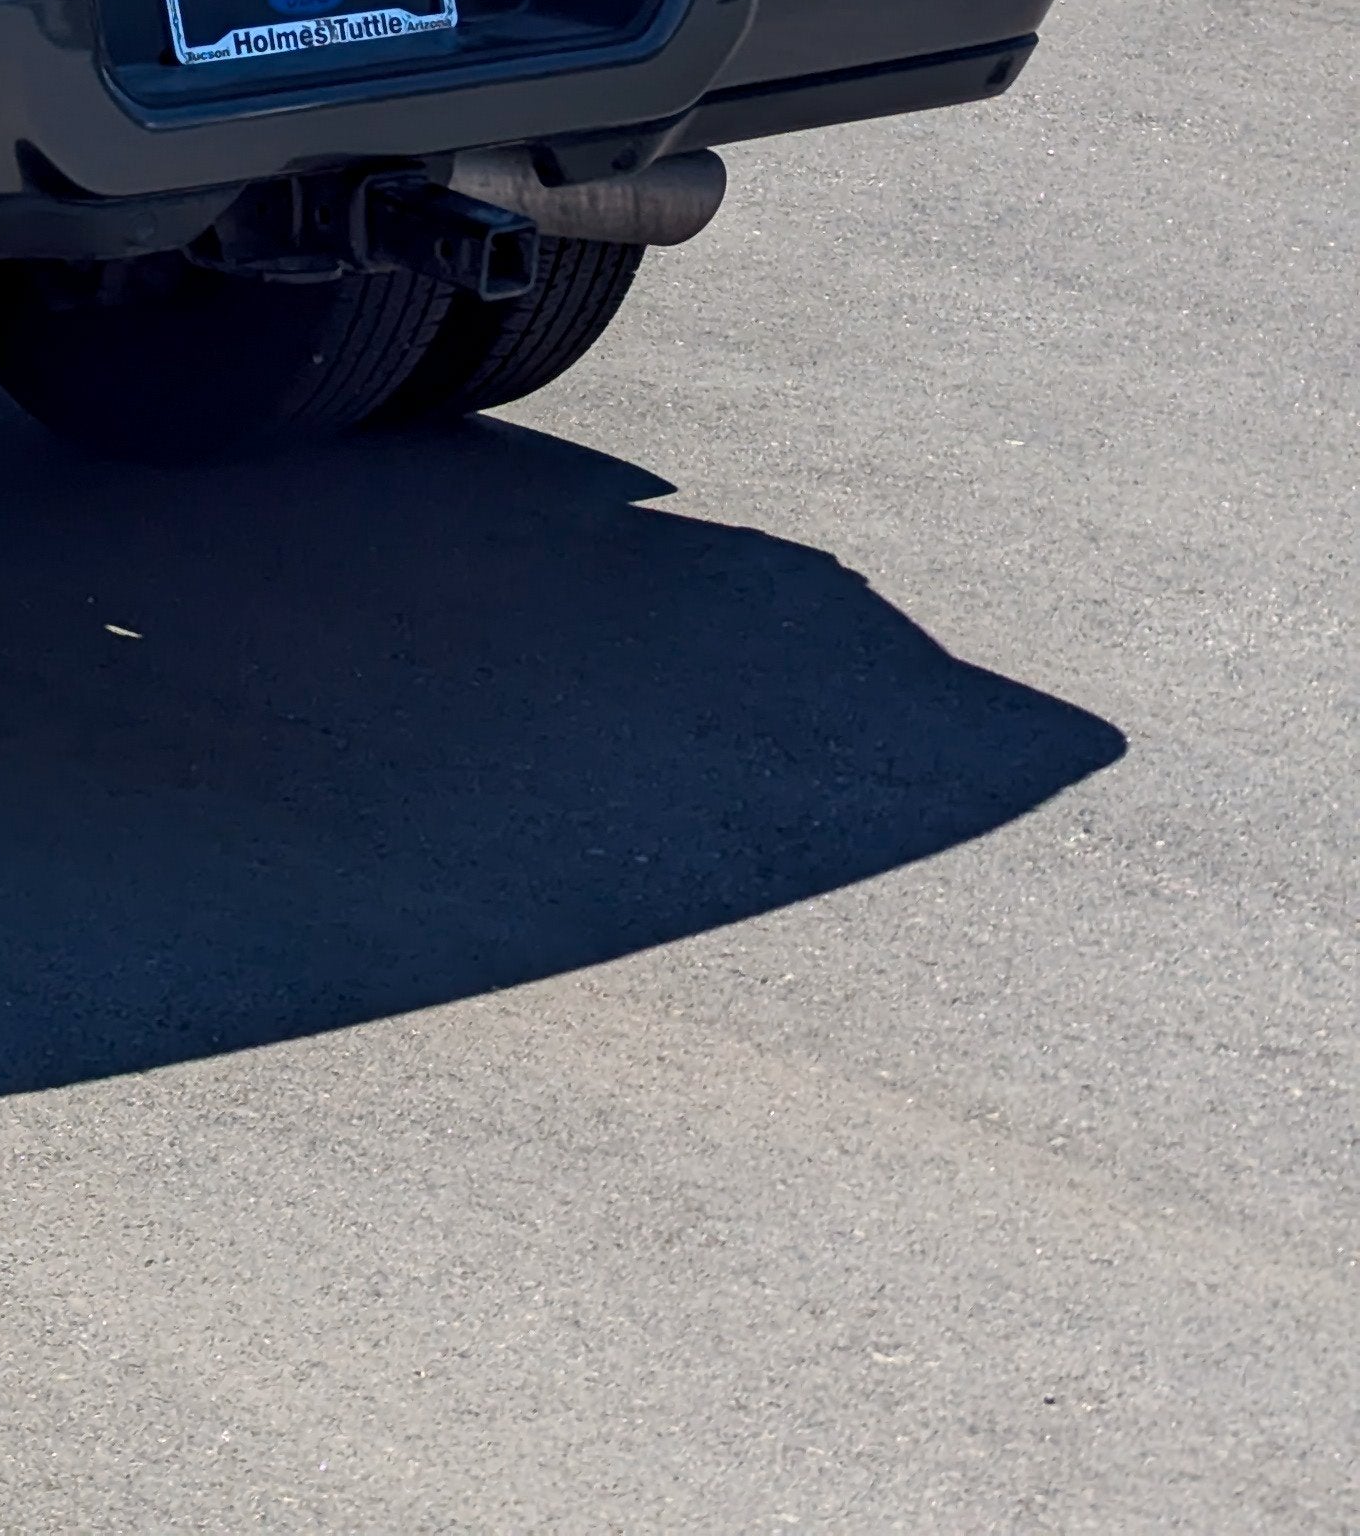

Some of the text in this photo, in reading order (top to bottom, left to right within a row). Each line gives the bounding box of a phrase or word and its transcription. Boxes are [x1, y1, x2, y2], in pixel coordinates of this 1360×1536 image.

[185, 46, 231, 64] Tucson
[233, 22, 329, 57] Holmes
[334, 13, 403, 41] Tuttle
